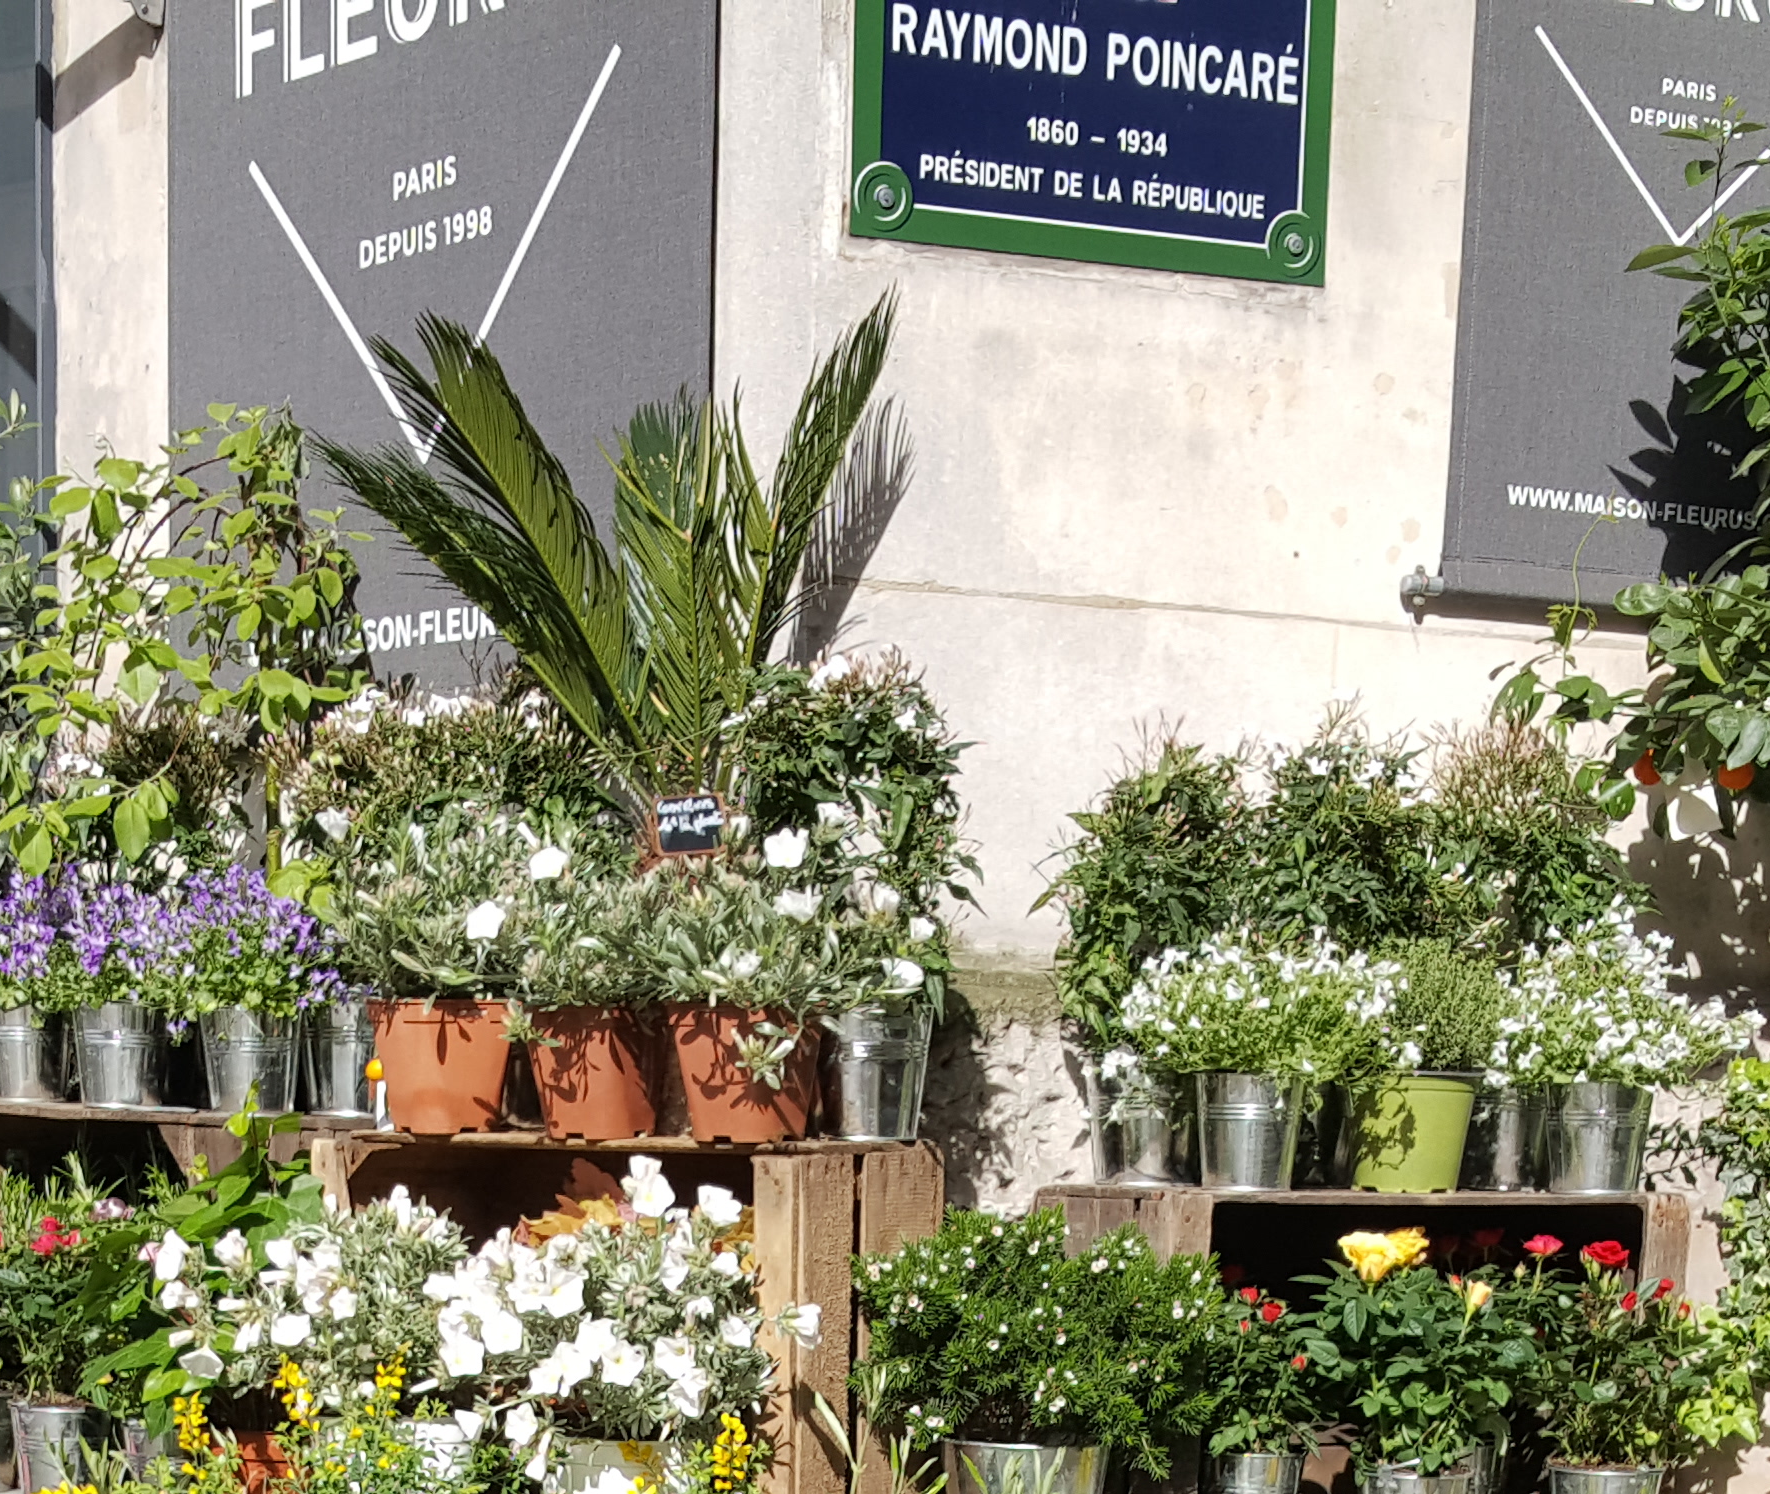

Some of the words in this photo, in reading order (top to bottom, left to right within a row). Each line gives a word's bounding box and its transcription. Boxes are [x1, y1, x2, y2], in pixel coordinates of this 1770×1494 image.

[236, 0, 506, 99] FLE
[891, 3, 1088, 76] RAYMOND
[1106, 33, 1300, 105] POINCARÉ
[1662, 77, 1717, 102] PARIS
[1027, 117, 1079, 147] 1860
[1117, 127, 1169, 158] 1934
[1630, 105, 1698, 130] DEPUIS
[393, 155, 457, 201] PARIS
[919, 150, 1045, 194] PRÉSIDENT
[1053, 170, 1084, 198] DE
[1093, 175, 1123, 203] LA
[1132, 174, 1266, 220] RÉPUBLIQUE
[359, 220, 437, 270] DEPUIS
[442, 205, 493, 246] 1998
